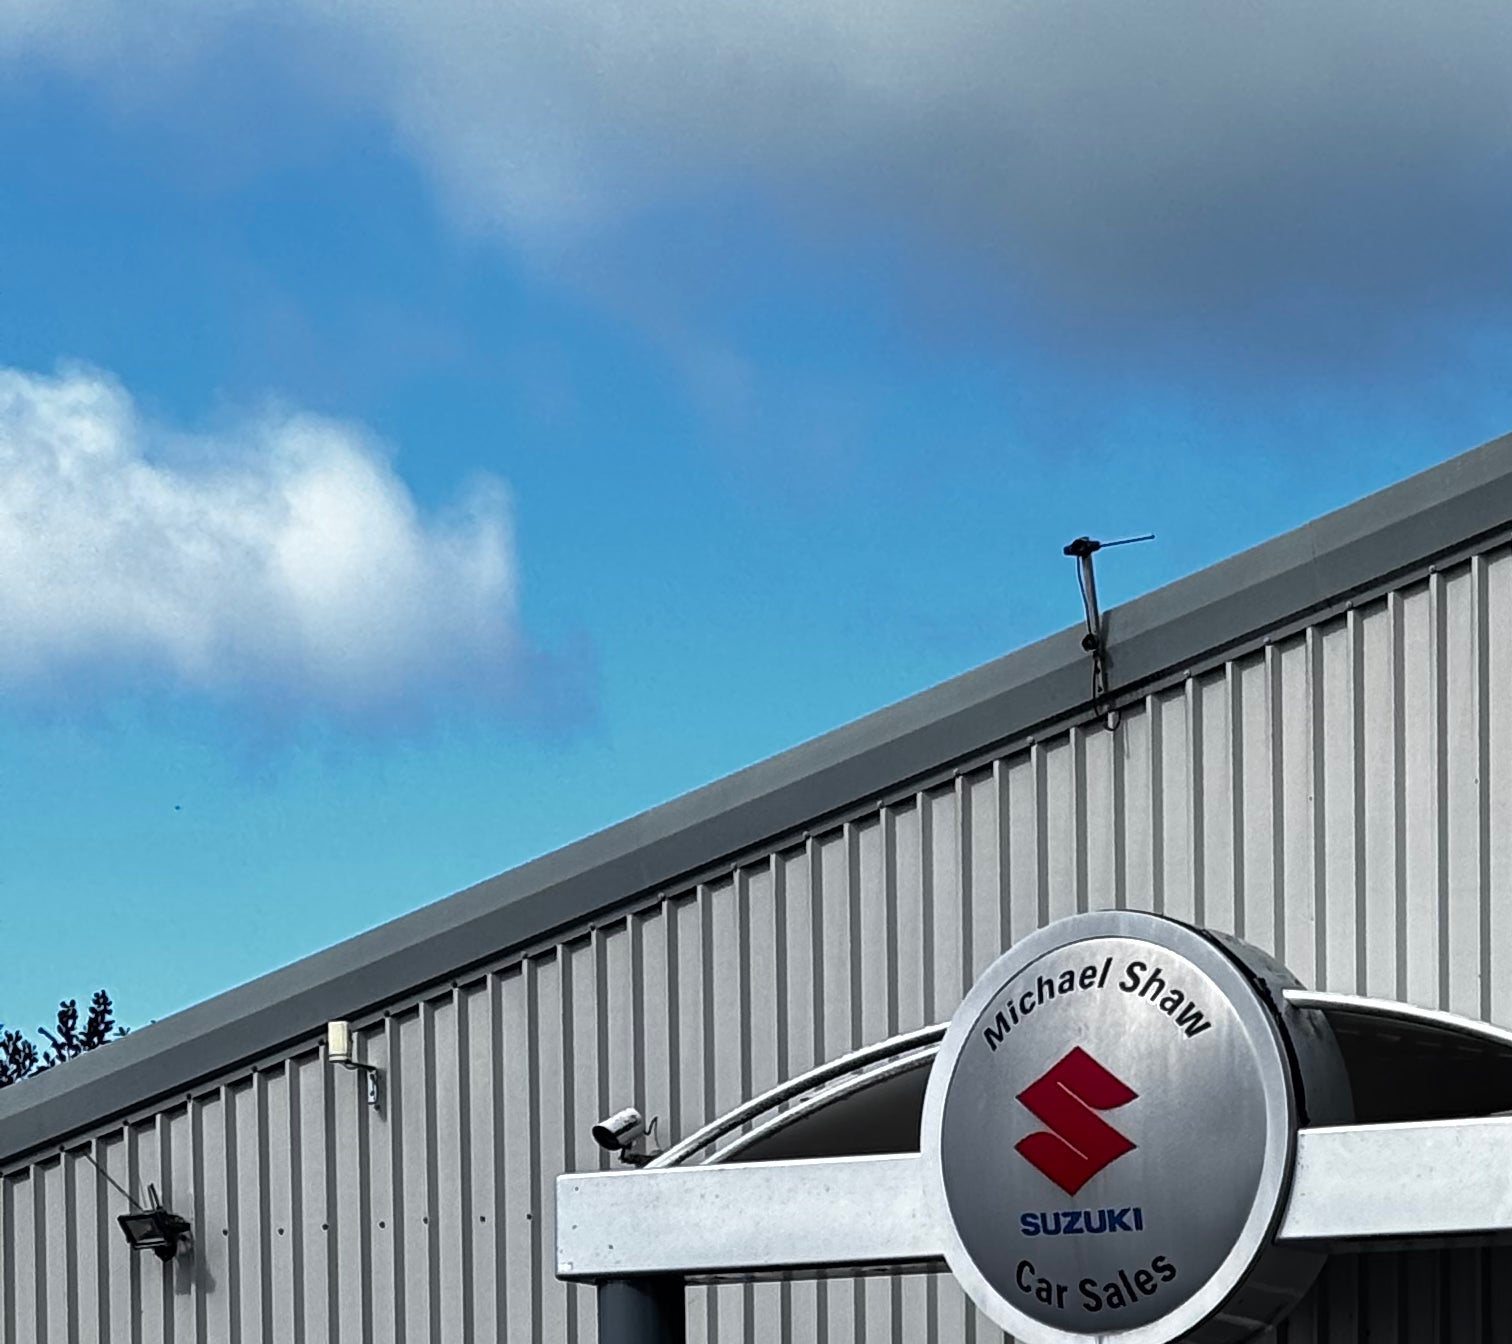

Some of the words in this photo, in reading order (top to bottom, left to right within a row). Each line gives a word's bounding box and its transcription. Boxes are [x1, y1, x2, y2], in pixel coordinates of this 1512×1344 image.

[983, 957, 1113, 1052] Michael
[1119, 961, 1212, 1039] Shaw
[1020, 1207, 1144, 1236] SUZUKI
[1016, 1260, 1068, 1309] Car
[1082, 1255, 1178, 1313] Sales
